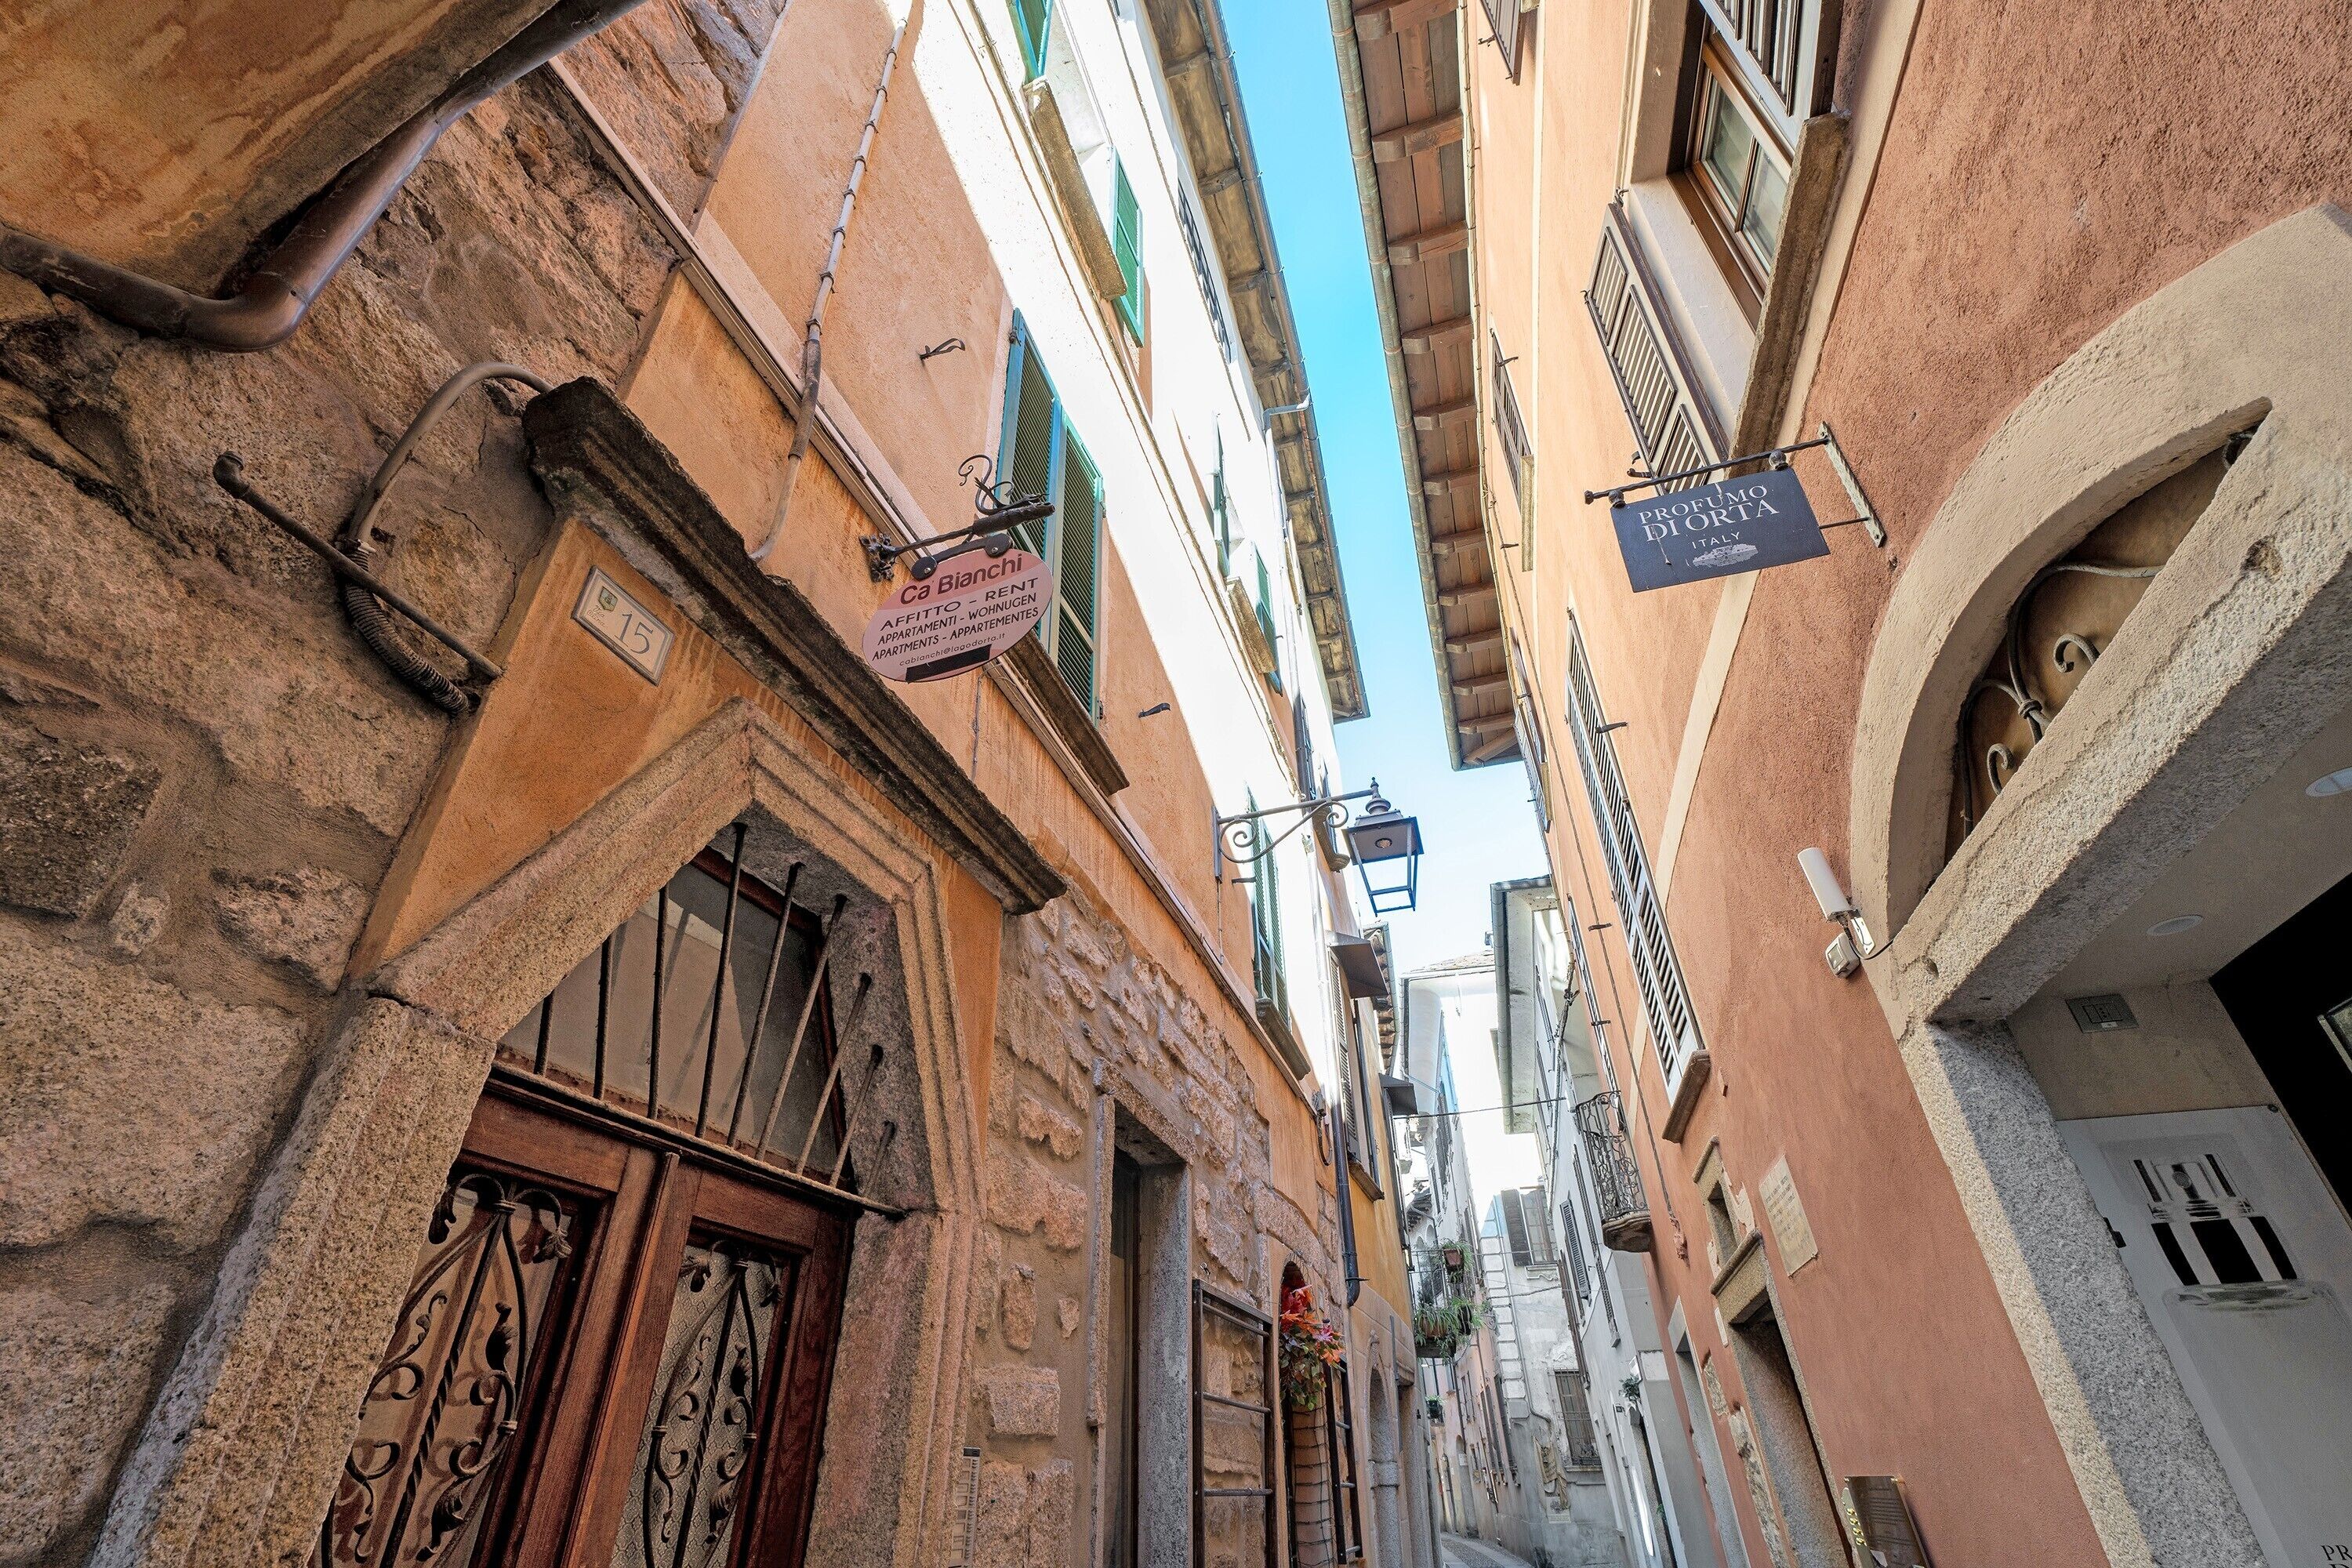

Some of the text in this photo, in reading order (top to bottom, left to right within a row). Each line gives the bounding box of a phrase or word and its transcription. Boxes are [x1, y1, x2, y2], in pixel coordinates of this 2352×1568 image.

[1638, 485, 1768, 524] PROFUMO
[1642, 499, 1780, 542] DI ORTA
[1692, 532, 1740, 549] ITALY
[937, 554, 1022, 594] Bianchi
[877, 615, 956, 646] APPARTAMENTI
[968, 593, 1036, 620] WOHNUGEN
[880, 601, 961, 631] AFFITTO
[985, 578, 1039, 601] RENT
[615, 612, 654, 655] 15
[872, 634, 939, 661] APARTMENTS
[949, 607, 1039, 640] APPARTEMENTES
[899, 633, 1005, 666] cabianchi@lagodorta.it
